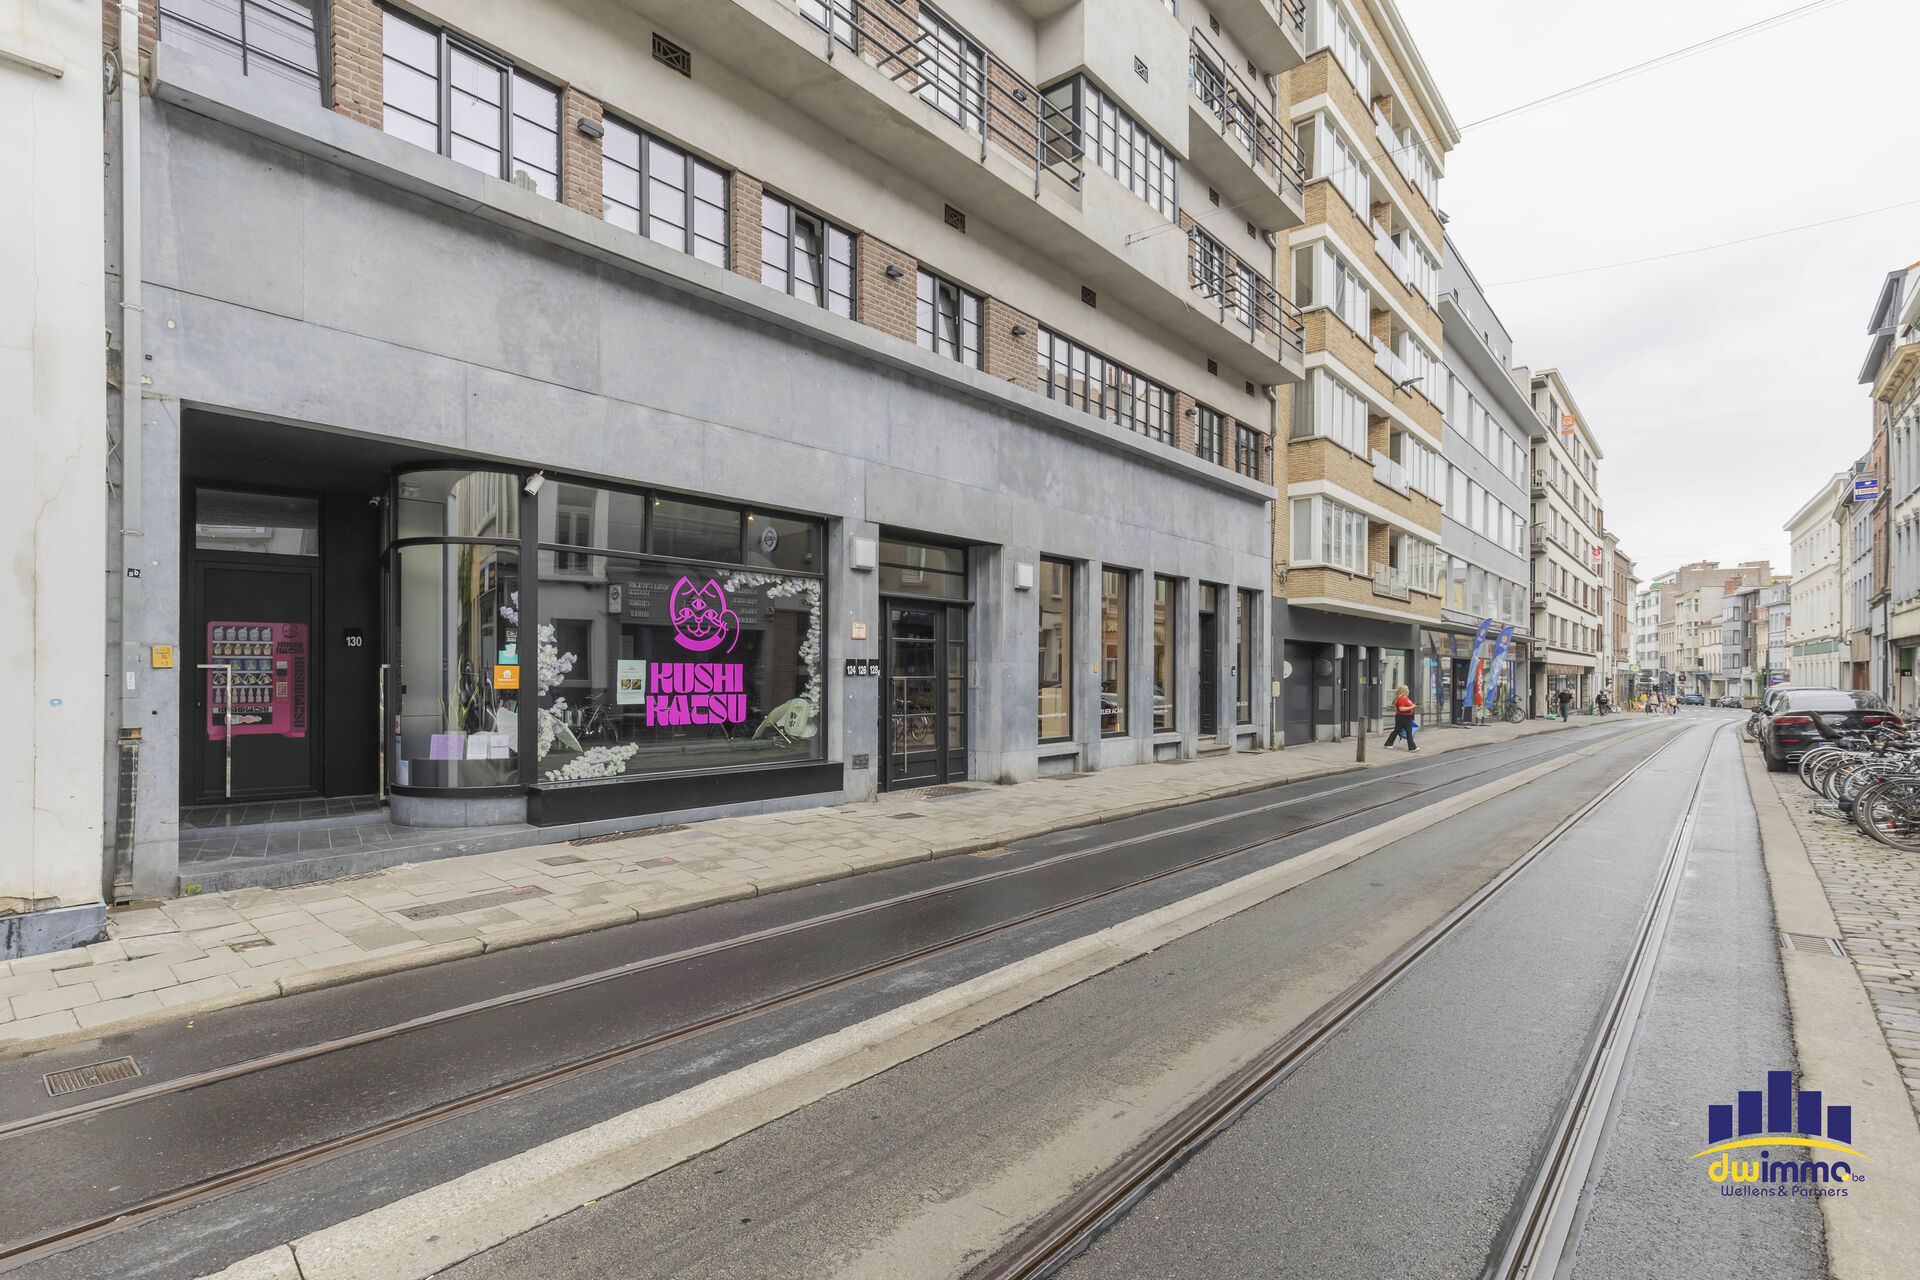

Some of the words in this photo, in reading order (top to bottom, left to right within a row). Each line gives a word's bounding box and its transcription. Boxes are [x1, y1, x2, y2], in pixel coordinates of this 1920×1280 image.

[346, 636, 362, 647] 130
[650, 662, 744, 693] KUSHI
[847, 665, 856, 675] 124
[858, 665, 867, 675] 126
[646, 694, 747, 727] KATSU
